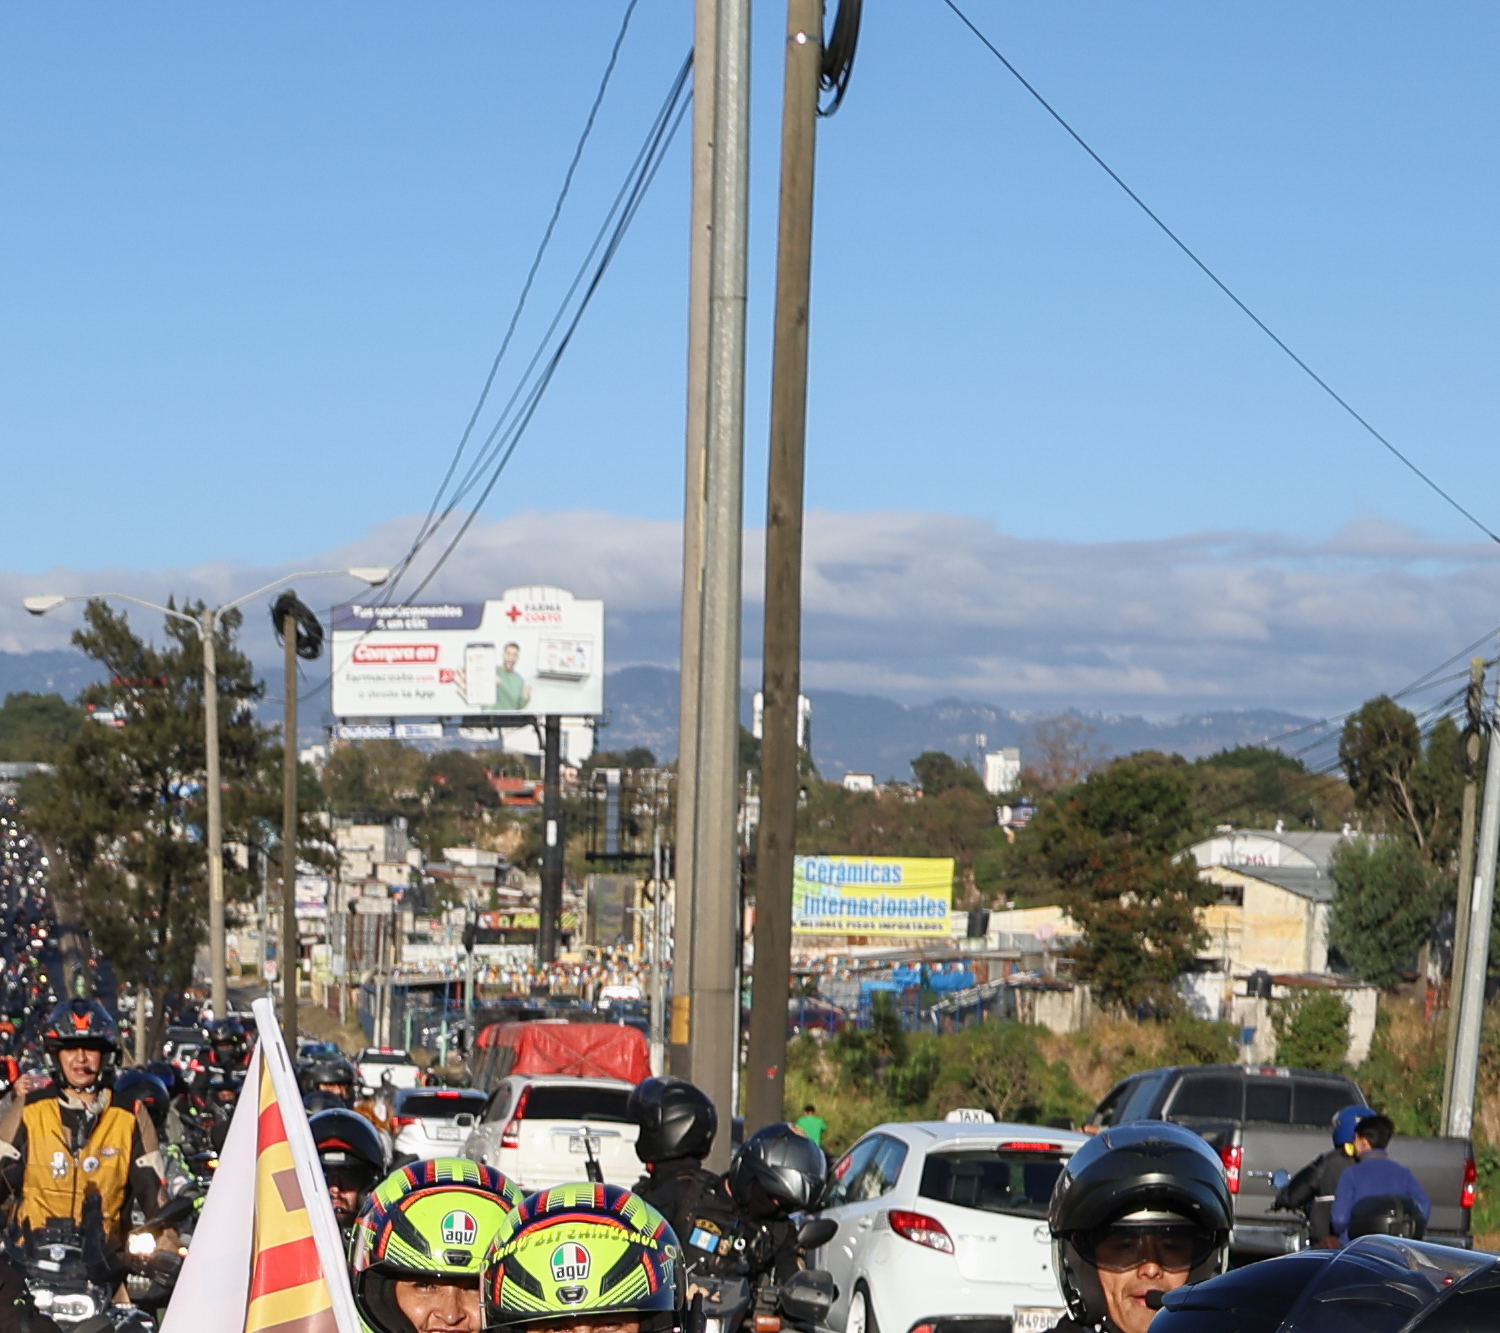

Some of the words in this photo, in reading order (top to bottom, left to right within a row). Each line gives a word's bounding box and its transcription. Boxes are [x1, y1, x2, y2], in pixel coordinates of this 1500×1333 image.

[355, 646, 413, 662] Compra
[416, 648, 436, 660] en
[805, 858, 902, 883] Cerámicas
[804, 894, 946, 918] Internacionales
[958, 1109, 985, 1124] TAXI
[446, 1229, 473, 1243] agv
[556, 1264, 586, 1281] agv
